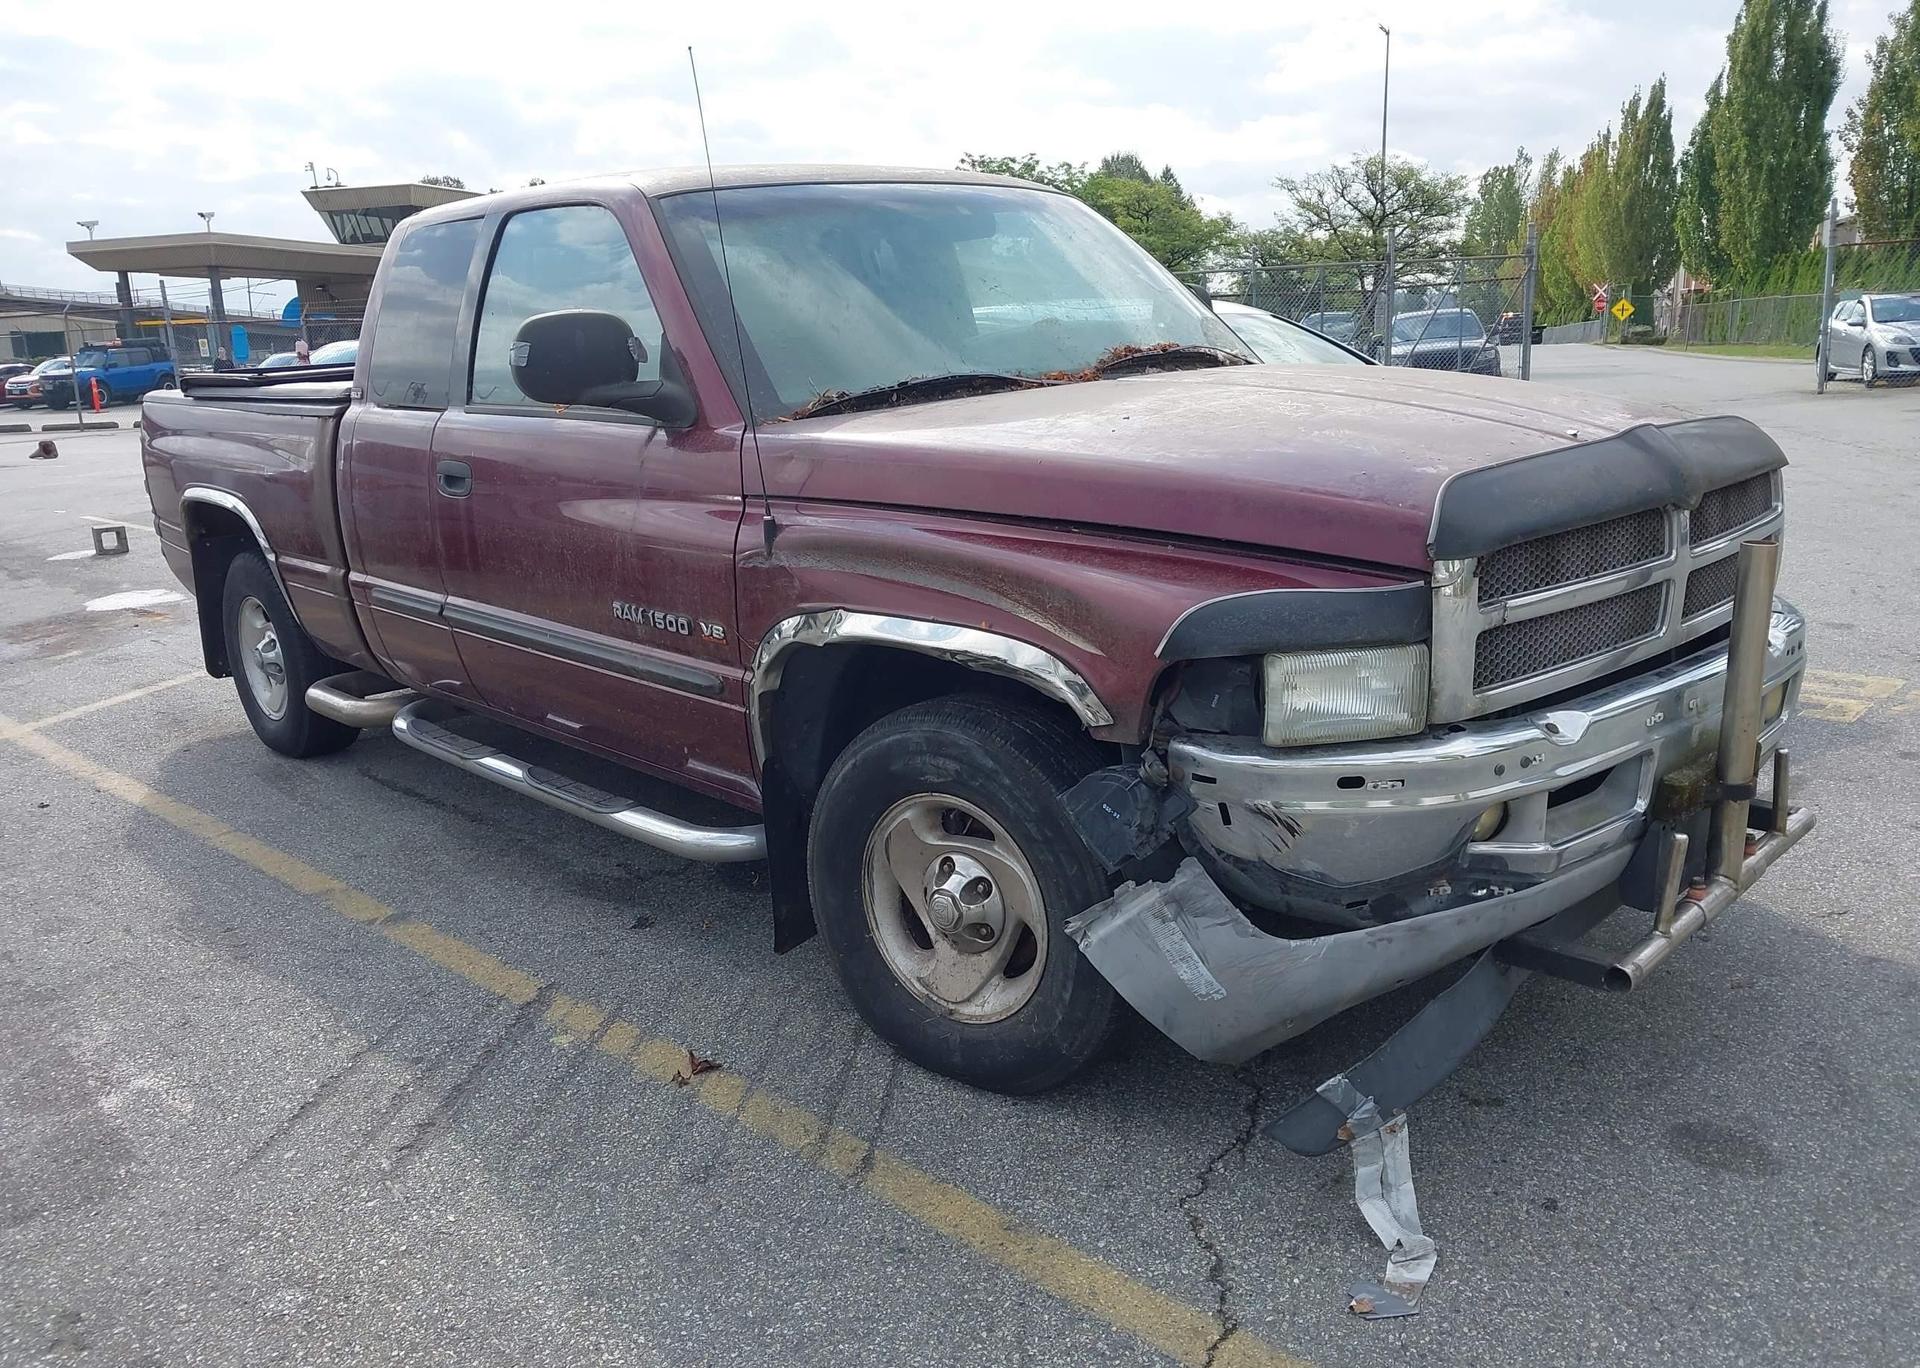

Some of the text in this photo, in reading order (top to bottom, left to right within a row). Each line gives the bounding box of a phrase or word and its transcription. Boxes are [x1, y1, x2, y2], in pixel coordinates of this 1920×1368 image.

[612, 601, 725, 639] RAM 1500 V8
